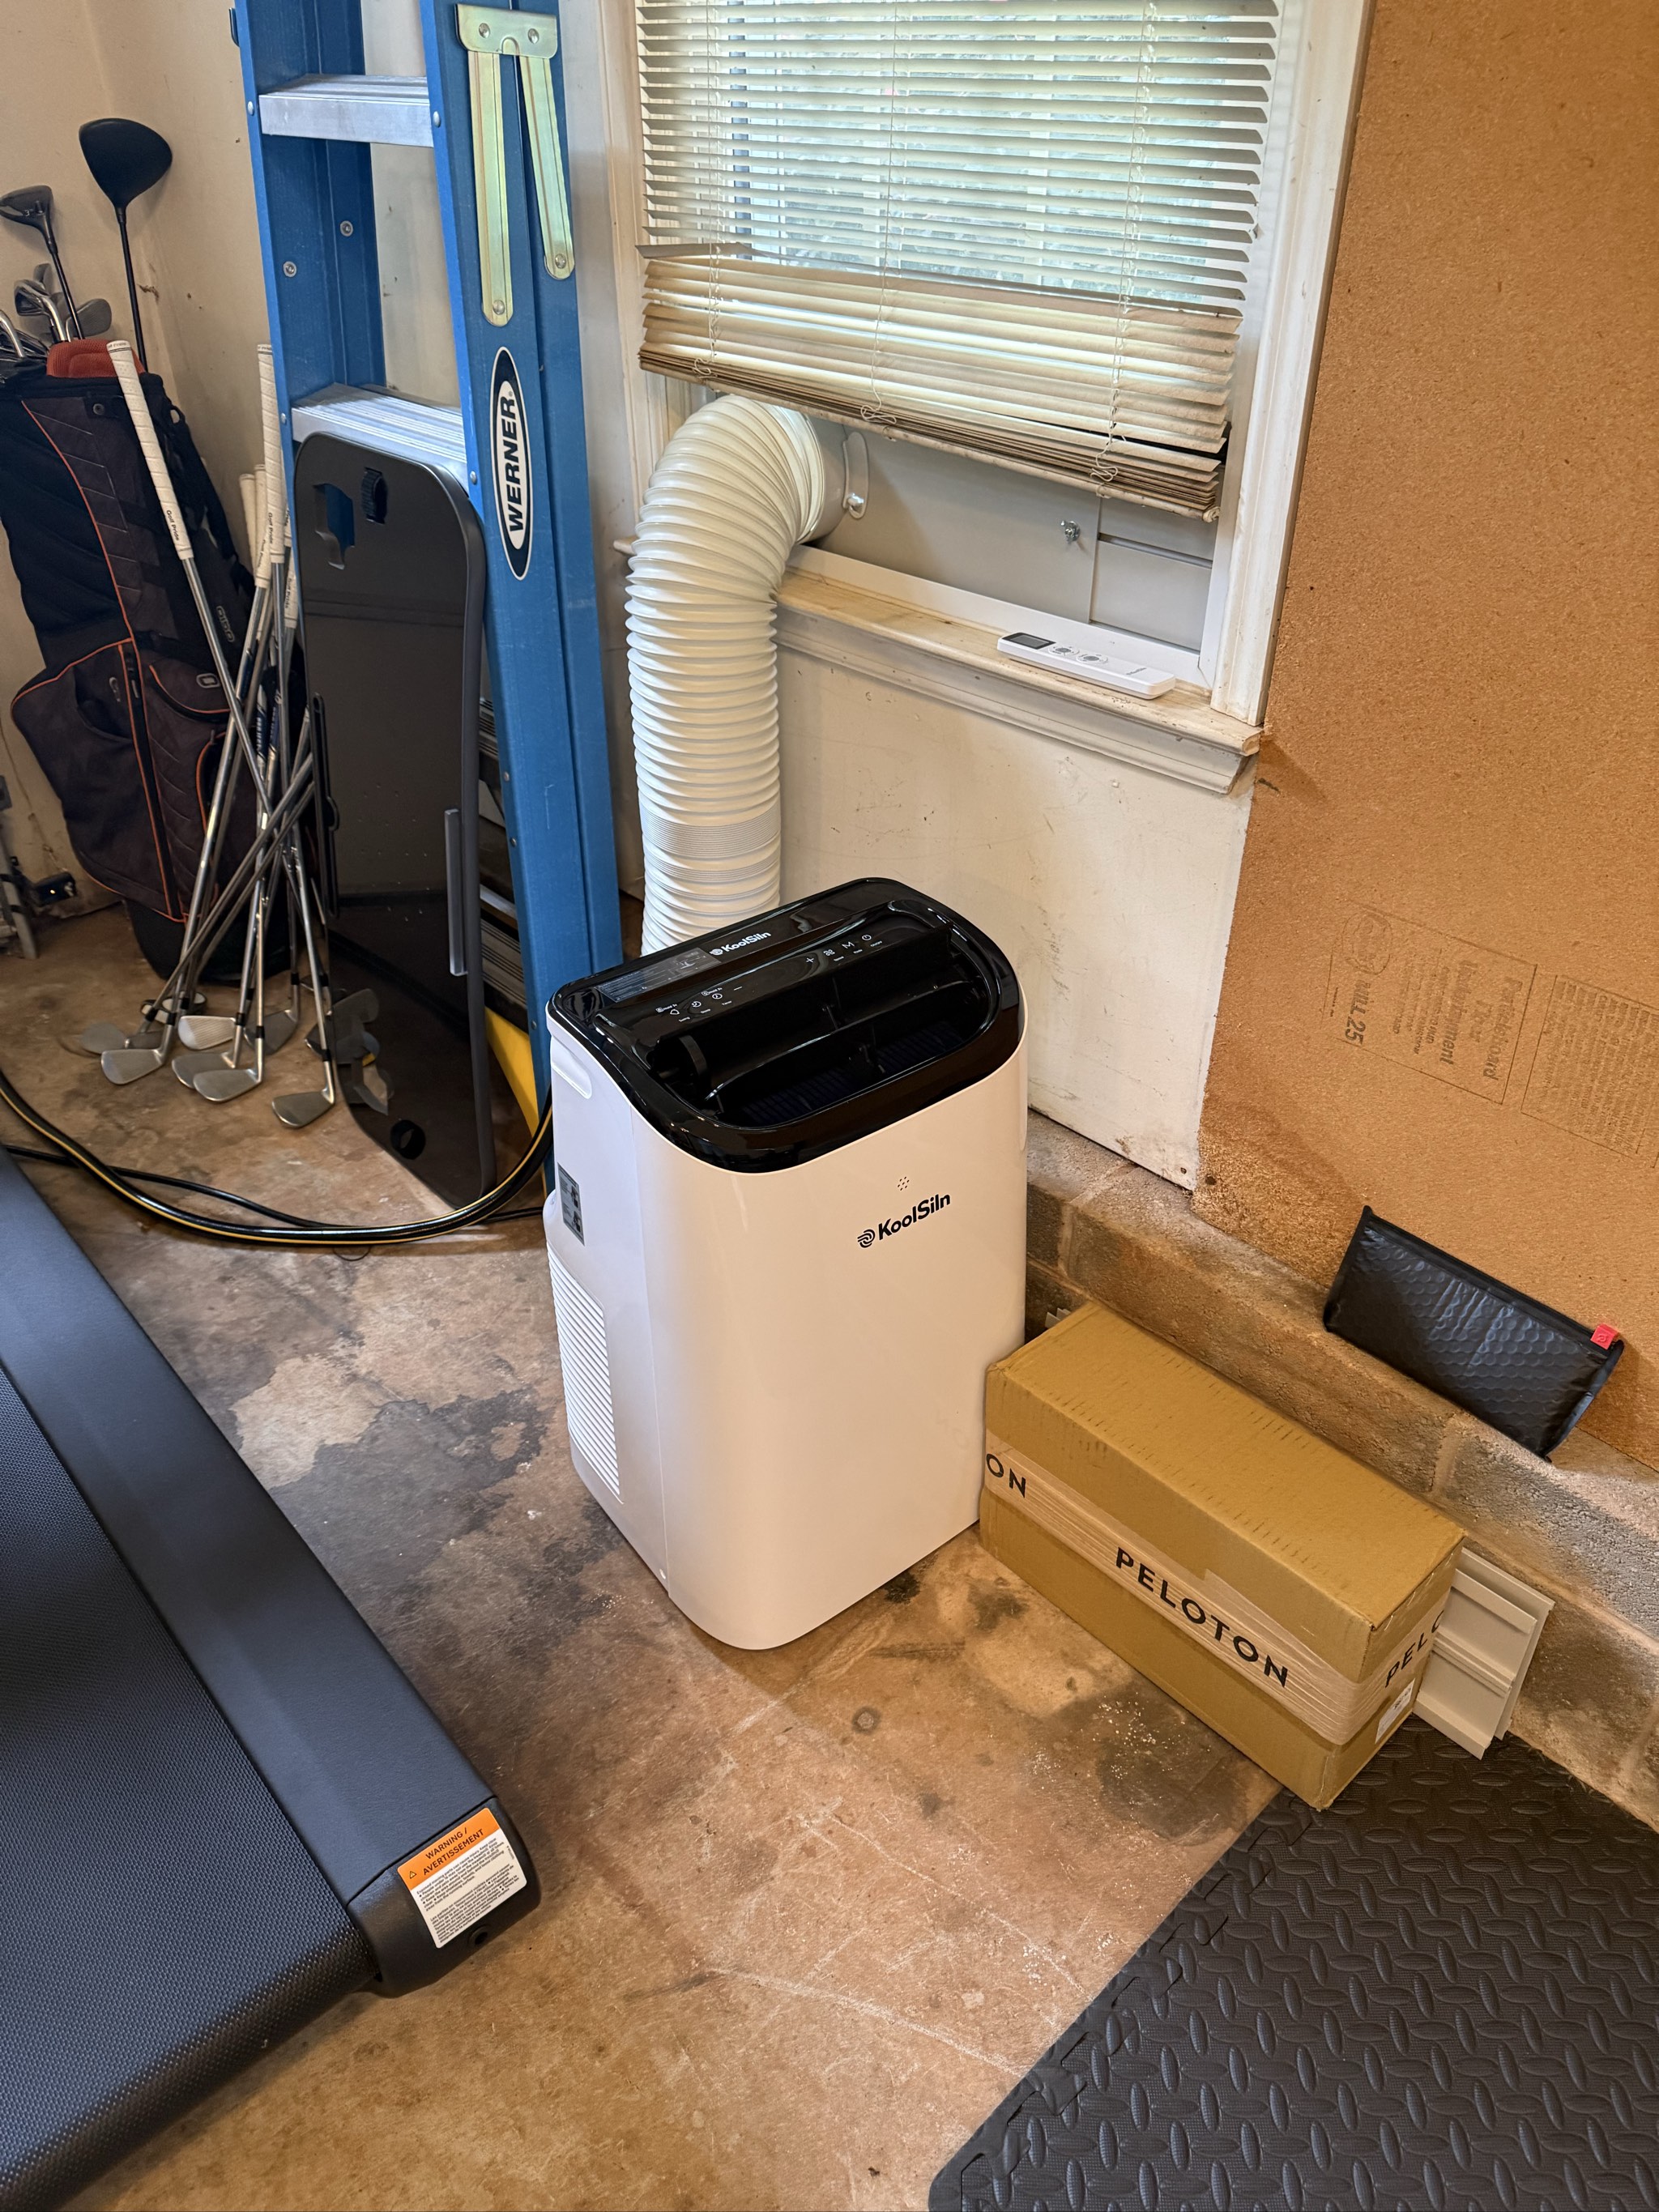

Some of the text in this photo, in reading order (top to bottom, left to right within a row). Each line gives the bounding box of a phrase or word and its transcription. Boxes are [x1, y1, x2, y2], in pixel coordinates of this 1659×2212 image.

[500, 396, 524, 532] WERNER
[171, 524, 180, 541] Pride
[721, 931, 772, 953] KoolSiln
[1345, 1015, 1367, 1046] 25
[878, 1194, 951, 1241] KoolSiln
[1115, 1546, 1289, 1689] PELOTON
[422, 1828, 484, 1876] AVERTISSEMENT
[425, 1831, 463, 1860] WARNING
